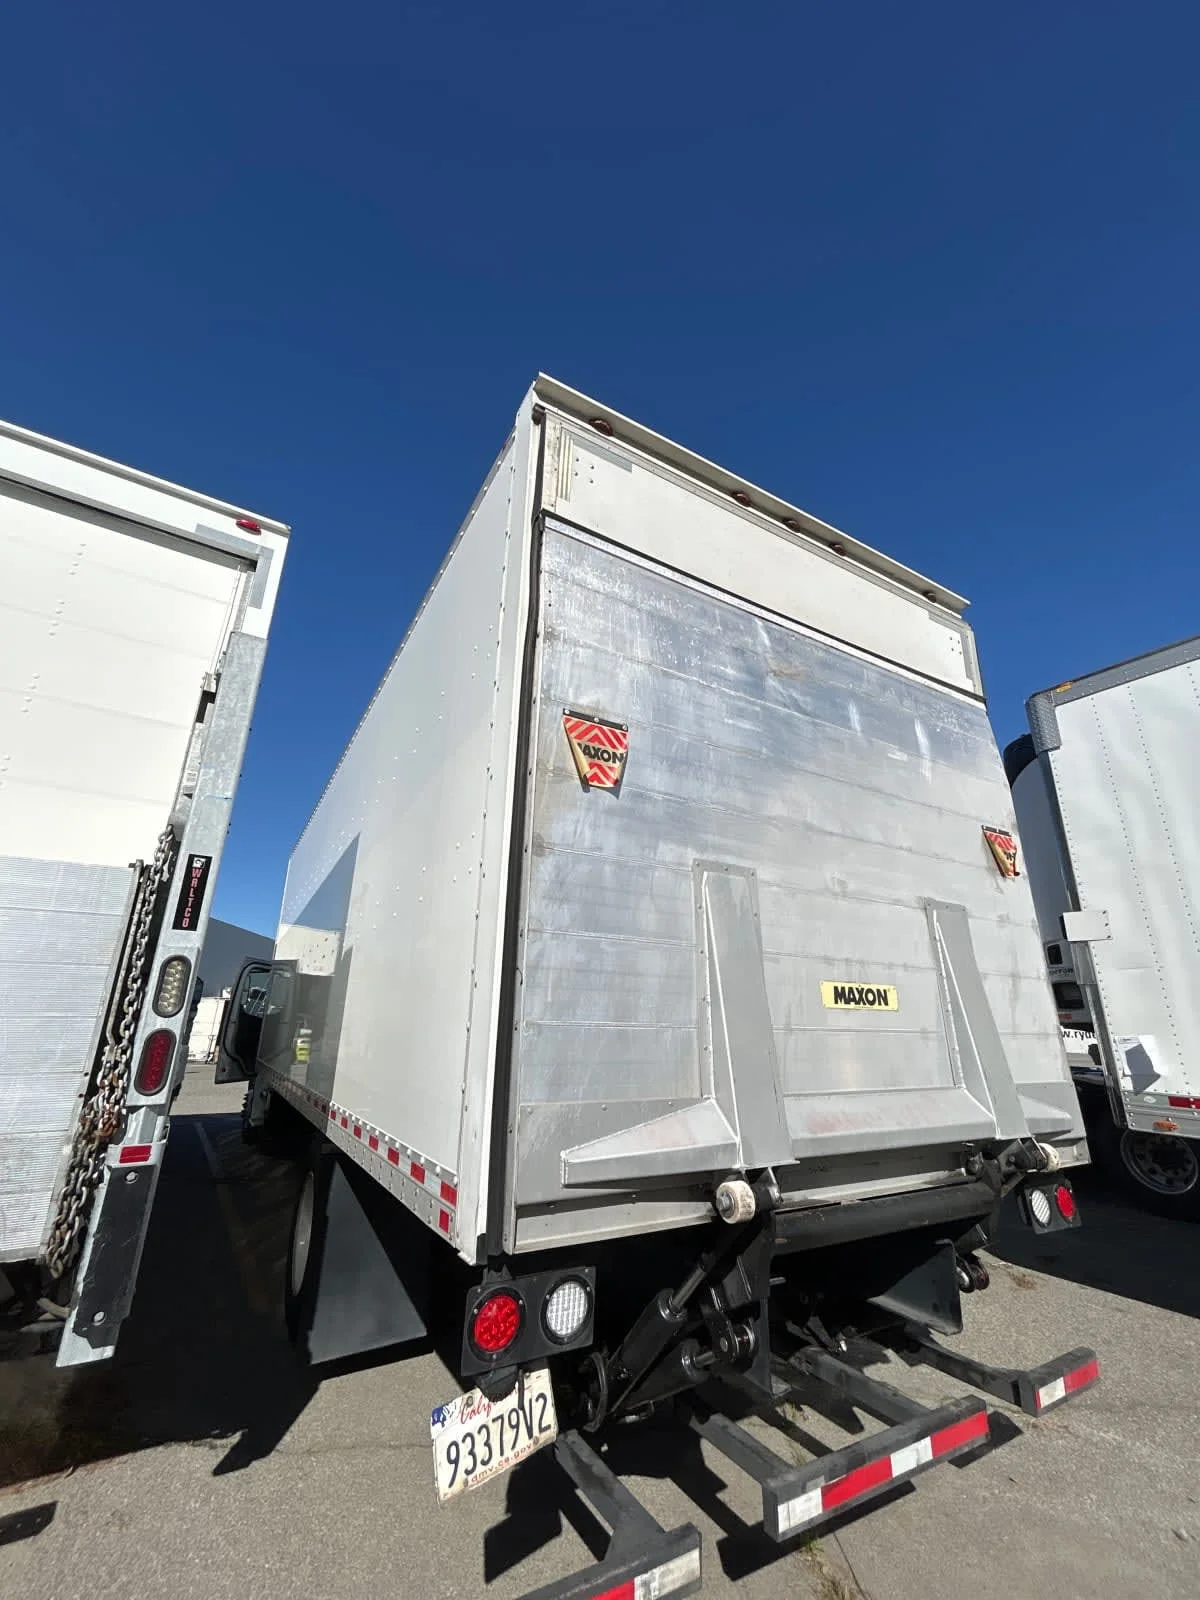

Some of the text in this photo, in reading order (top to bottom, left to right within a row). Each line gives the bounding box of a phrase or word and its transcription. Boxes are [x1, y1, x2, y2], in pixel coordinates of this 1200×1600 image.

[577, 742, 625, 764] AXON
[182, 868, 202, 928] WALTCO
[833, 985, 889, 1007] MAXON
[446, 1392, 552, 1488] 93379V2
[471, 1441, 532, 1483] dmv.ca.gov
